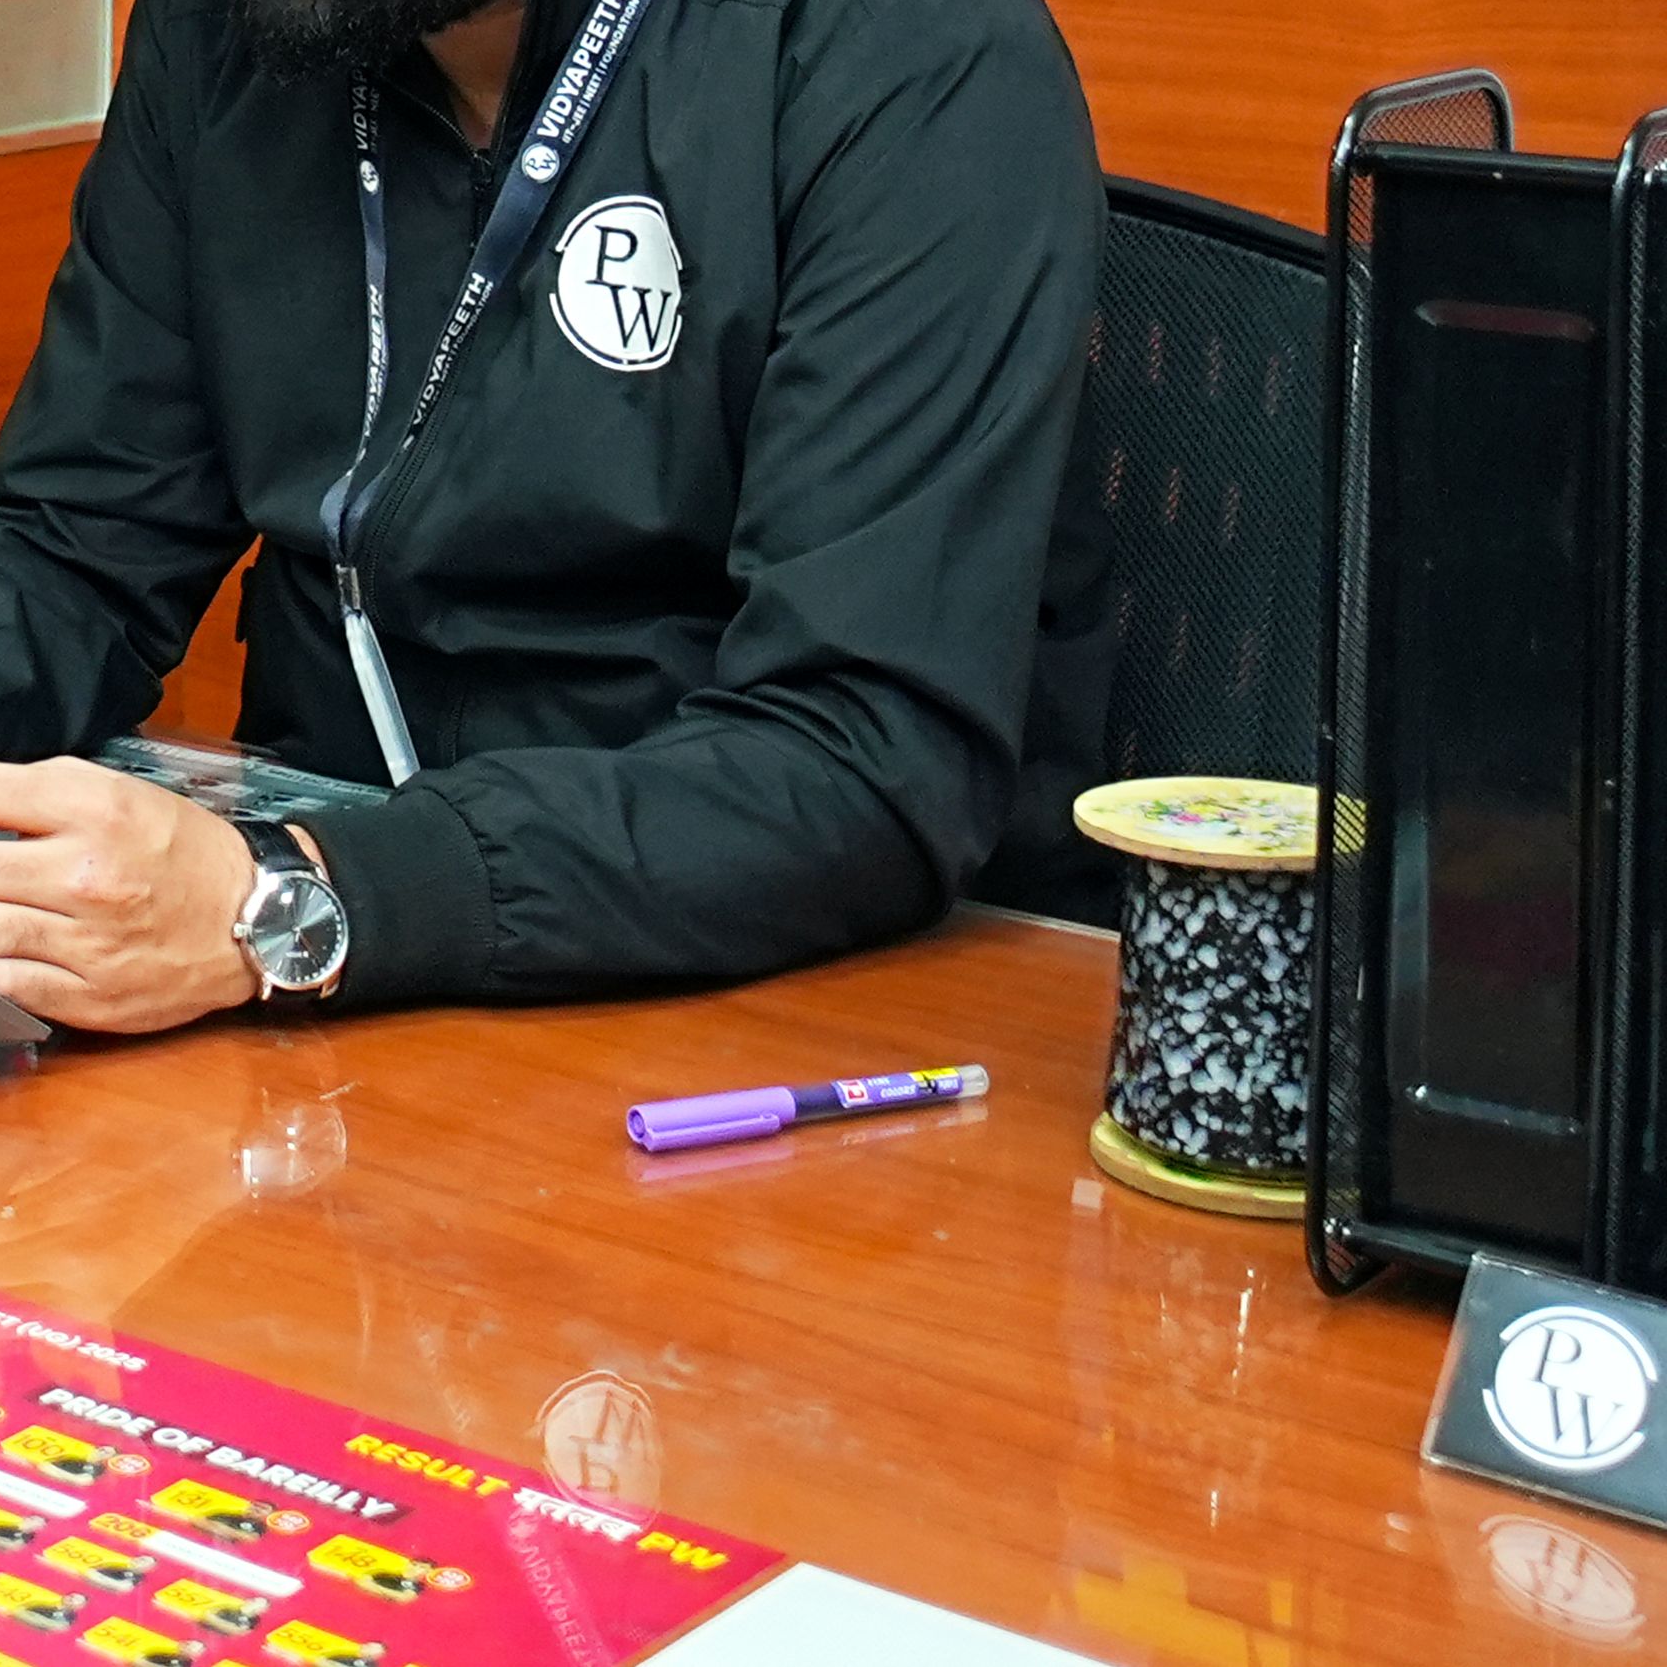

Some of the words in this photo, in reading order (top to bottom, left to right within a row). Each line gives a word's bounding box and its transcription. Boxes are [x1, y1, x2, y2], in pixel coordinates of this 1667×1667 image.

[412, 272, 486, 425] VIDYAPEETH
[77, 1341, 148, 1373] 2025
[14, 1433, 65, 1458] 100
[38, 1385, 157, 1436] PRIDE
[151, 1426, 215, 1454] OF
[205, 1445, 398, 1520] BAREILLY
[344, 1433, 511, 1497] RESULT
[512, 1485, 643, 1544] मतलब
[636, 1530, 730, 1571] PW
